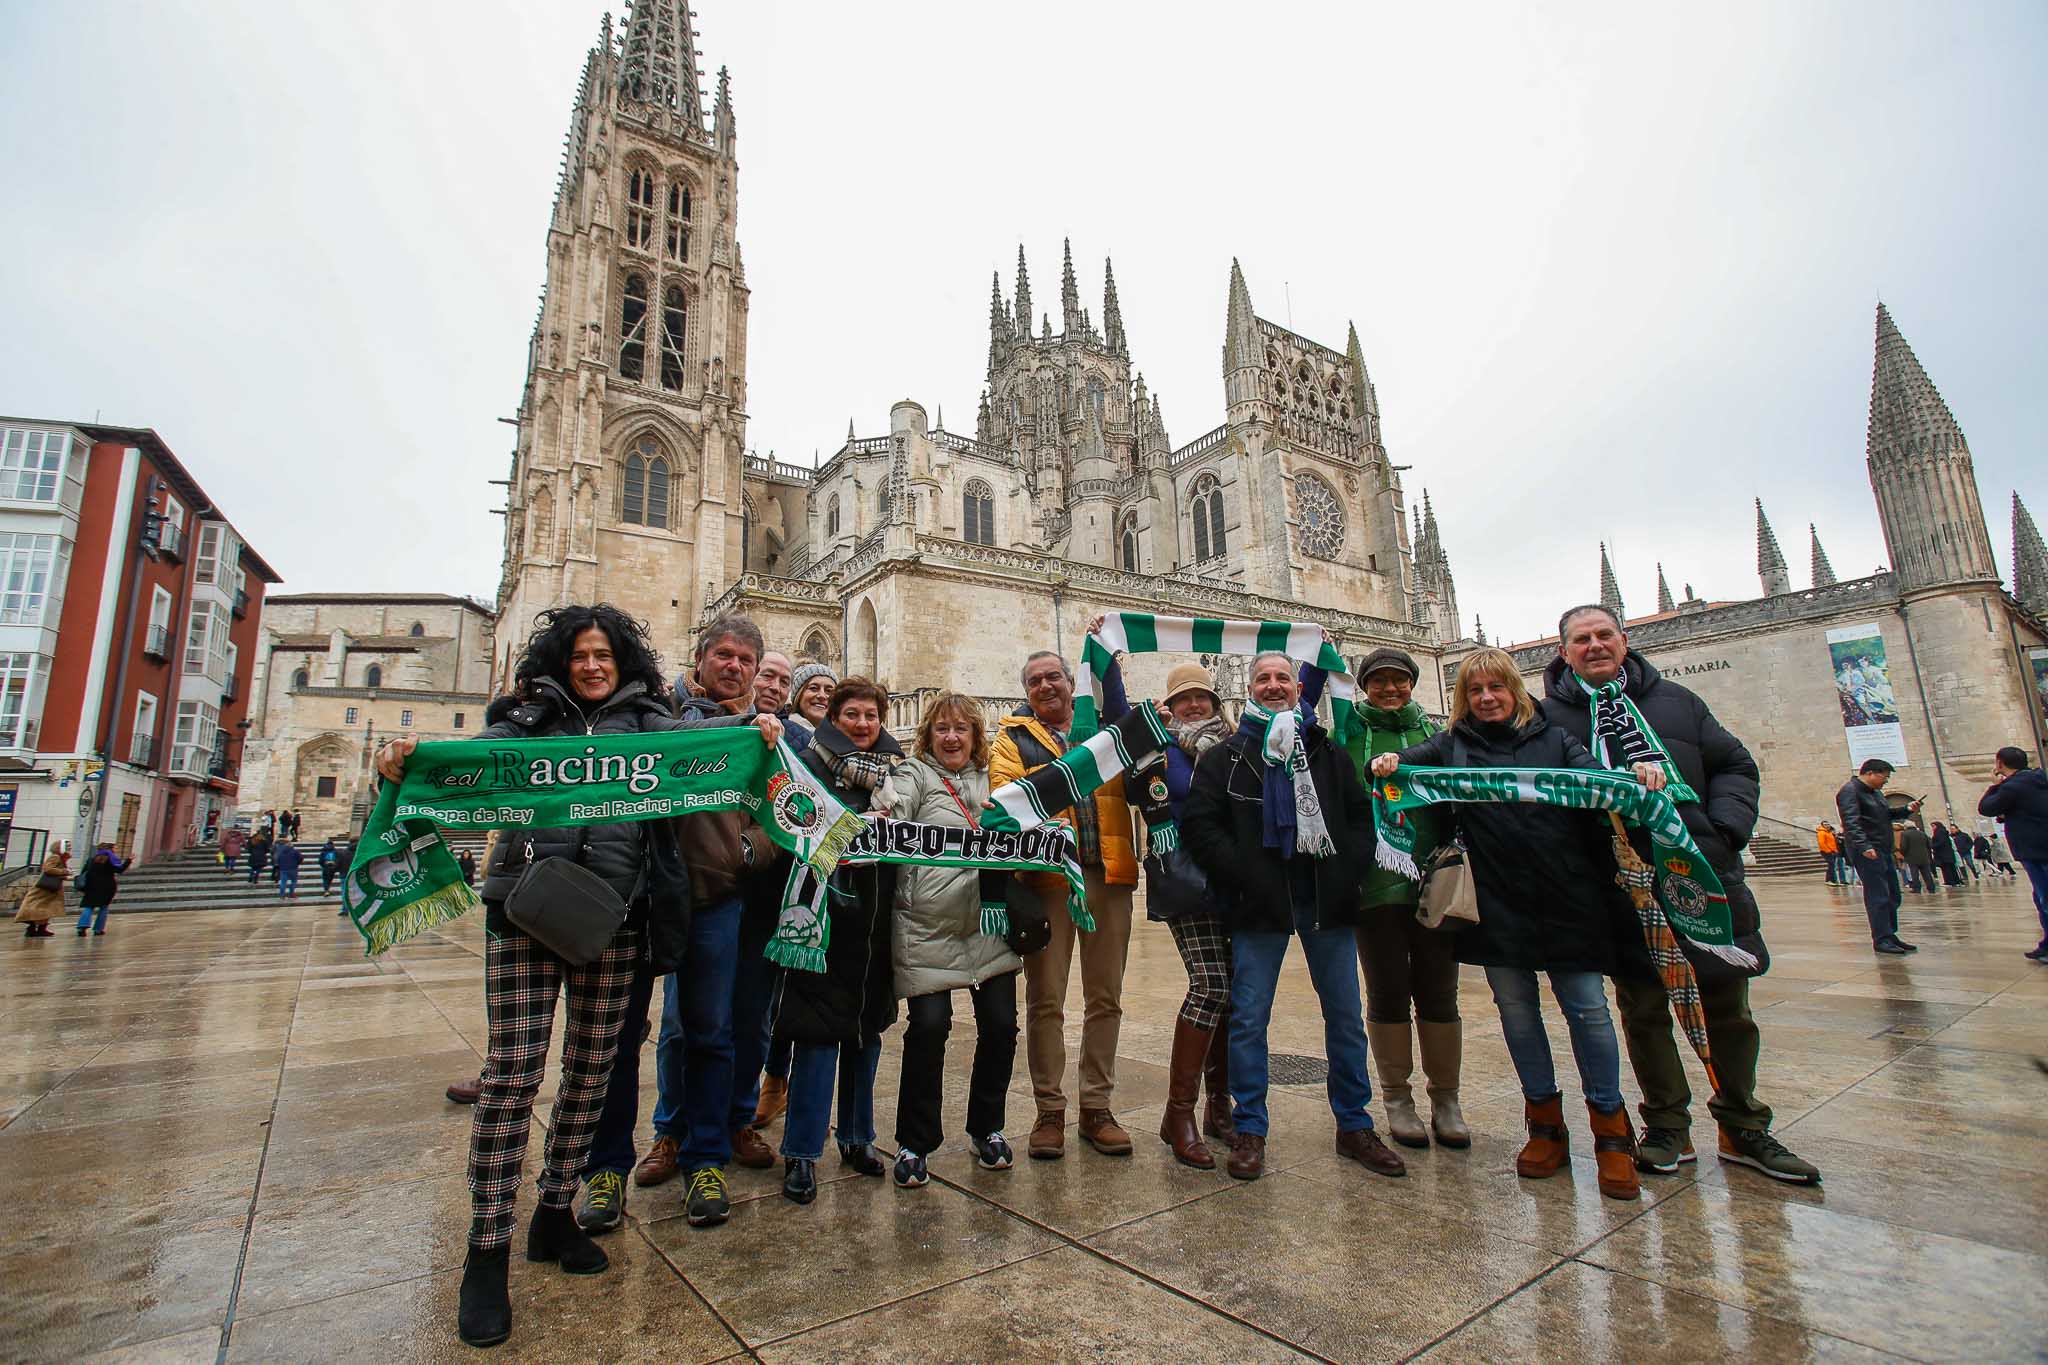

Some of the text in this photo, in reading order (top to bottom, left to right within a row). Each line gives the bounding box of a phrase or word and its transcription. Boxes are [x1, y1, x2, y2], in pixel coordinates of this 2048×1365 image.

[425, 746, 729, 795] Real Racing Club
[1415, 771, 1520, 804] RACING
[473, 807, 496, 822] de
[498, 806, 534, 824] Rey
[570, 802, 610, 819] Real
[612, 798, 671, 817] Racing
[684, 790, 720, 808] Real
